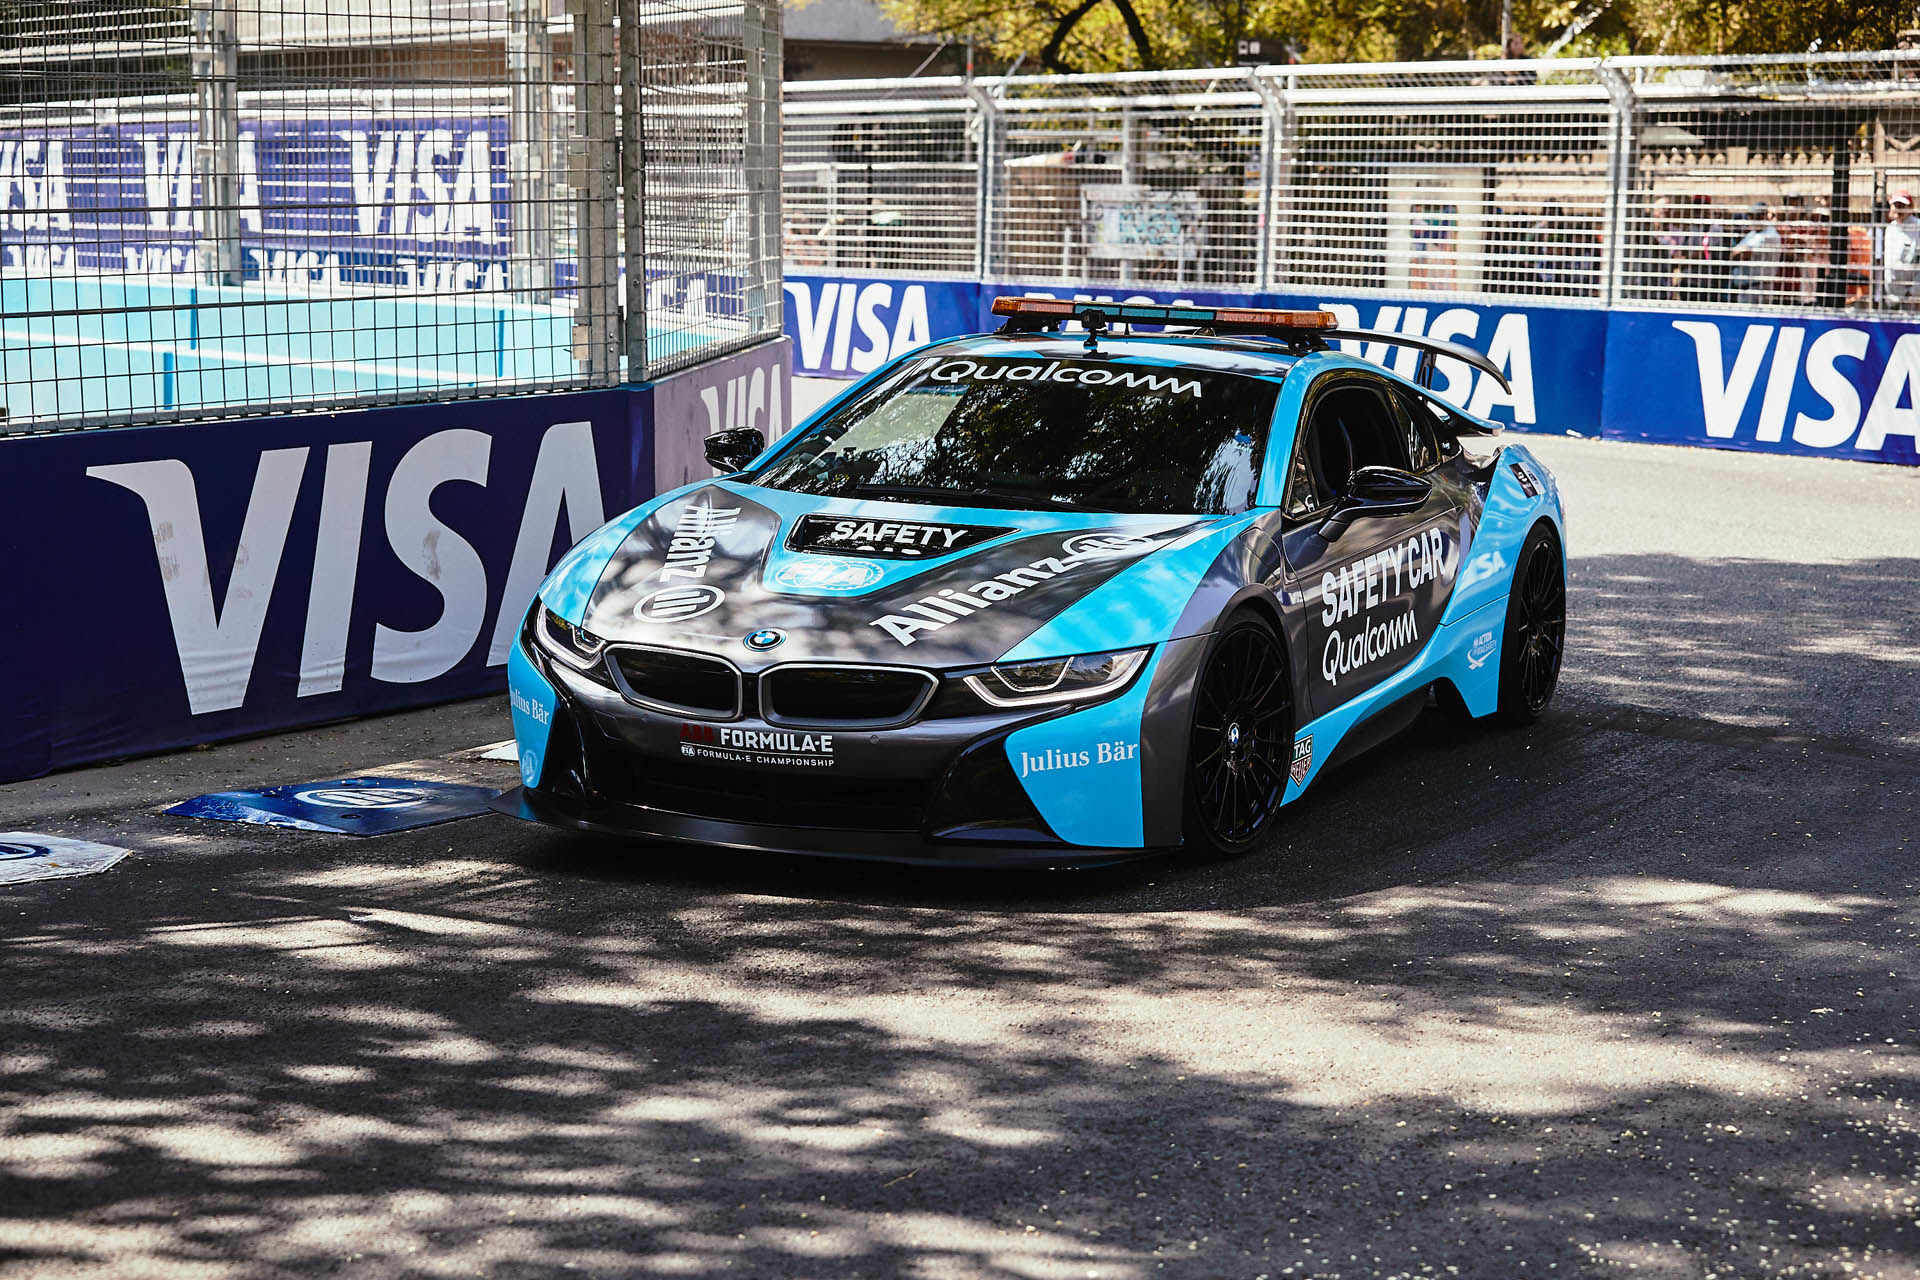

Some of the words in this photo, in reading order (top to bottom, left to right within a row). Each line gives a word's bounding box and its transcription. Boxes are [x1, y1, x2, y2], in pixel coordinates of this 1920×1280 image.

[0, 138, 72, 231] ISA
[133, 131, 262, 233] VIA
[340, 129, 498, 245] VISA
[783, 282, 930, 373] VISA
[1319, 303, 1536, 424] VISA
[931, 361, 1202, 398] Qualcomm
[1672, 320, 1920, 454] VISA
[86, 421, 608, 715] VISA
[831, 520, 968, 548] SAFETY
[1321, 543, 1403, 627] SAFETY
[1407, 527, 1446, 589] CAR
[868, 556, 1084, 647] Allianz
[1321, 609, 1418, 686] Qualcomm
[532, 697, 550, 726] Bär
[720, 727, 834, 753] FORMULA-E
[1293, 738, 1311, 759] TAG
[697, 748, 751, 763] FORMULA-E
[756, 755, 835, 767] CHAMPIONSHIP
[1020, 748, 1090, 778] Julius
[1096, 740, 1138, 764] Bär
